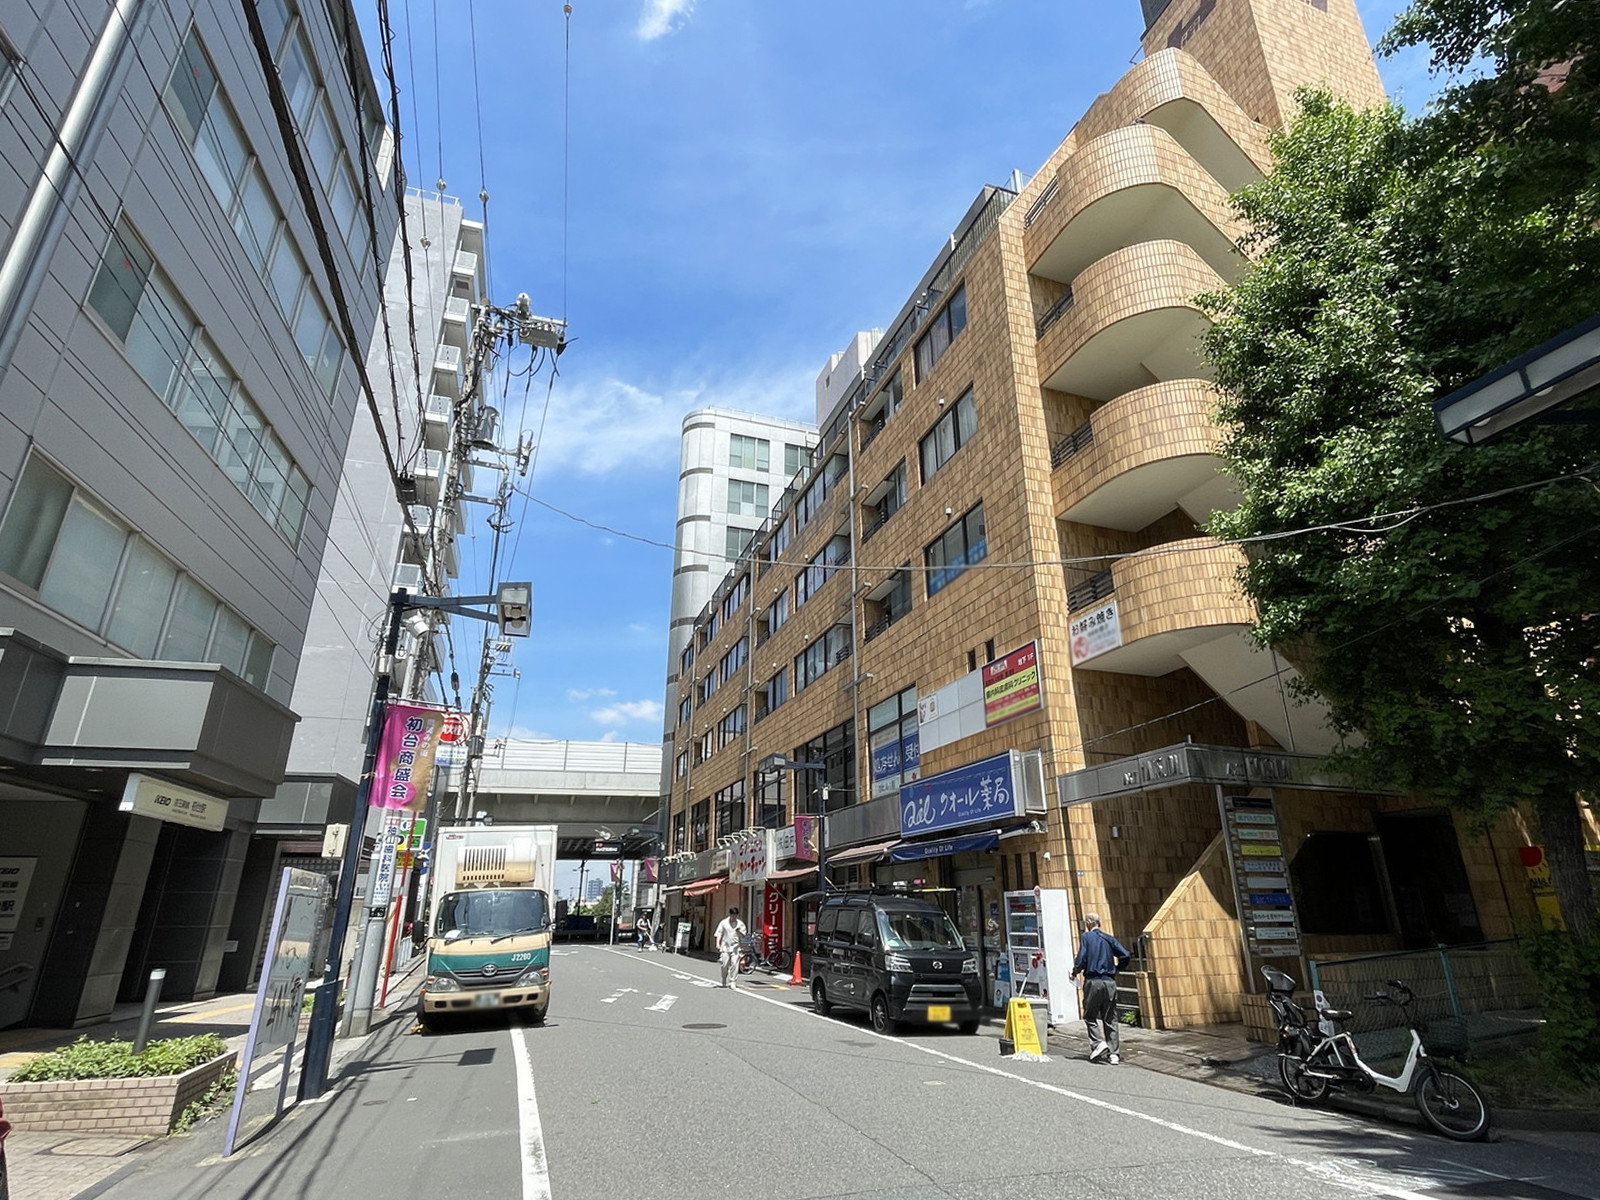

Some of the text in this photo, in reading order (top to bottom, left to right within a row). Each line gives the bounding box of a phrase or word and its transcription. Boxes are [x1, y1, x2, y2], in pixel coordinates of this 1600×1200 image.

[1071, 607, 1114, 637] お好み焼き
[389, 717, 423, 798] 初台商盛会
[940, 775, 1010, 816] クオール薬局
